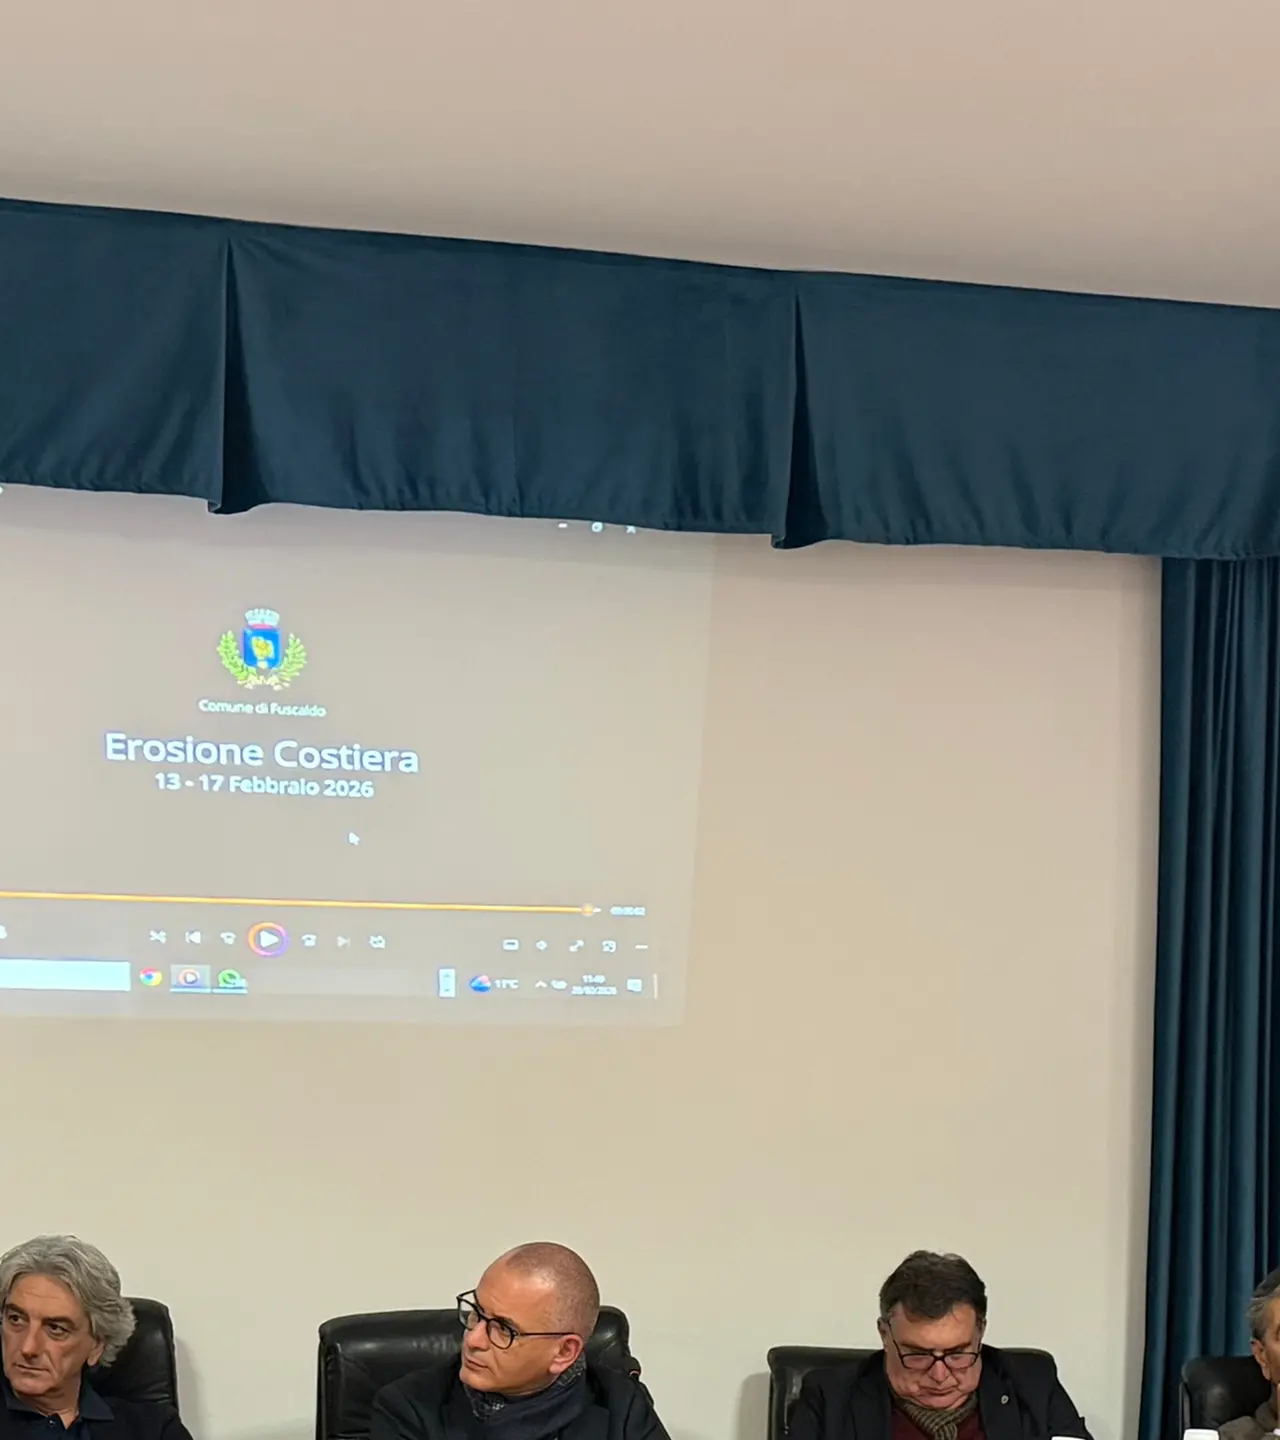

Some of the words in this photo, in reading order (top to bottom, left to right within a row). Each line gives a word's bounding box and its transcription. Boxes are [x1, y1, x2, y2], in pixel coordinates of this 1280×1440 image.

[199, 700, 253, 714] Comune
[256, 702, 268, 714] di
[271, 702, 326, 717] Fuscaldo
[105, 732, 264, 766] Erosione
[274, 740, 419, 774] Costiera
[155, 773, 181, 790] 13
[199, 775, 223, 792] 17
[229, 776, 320, 796] Febbraio
[323, 780, 374, 798] 2026
